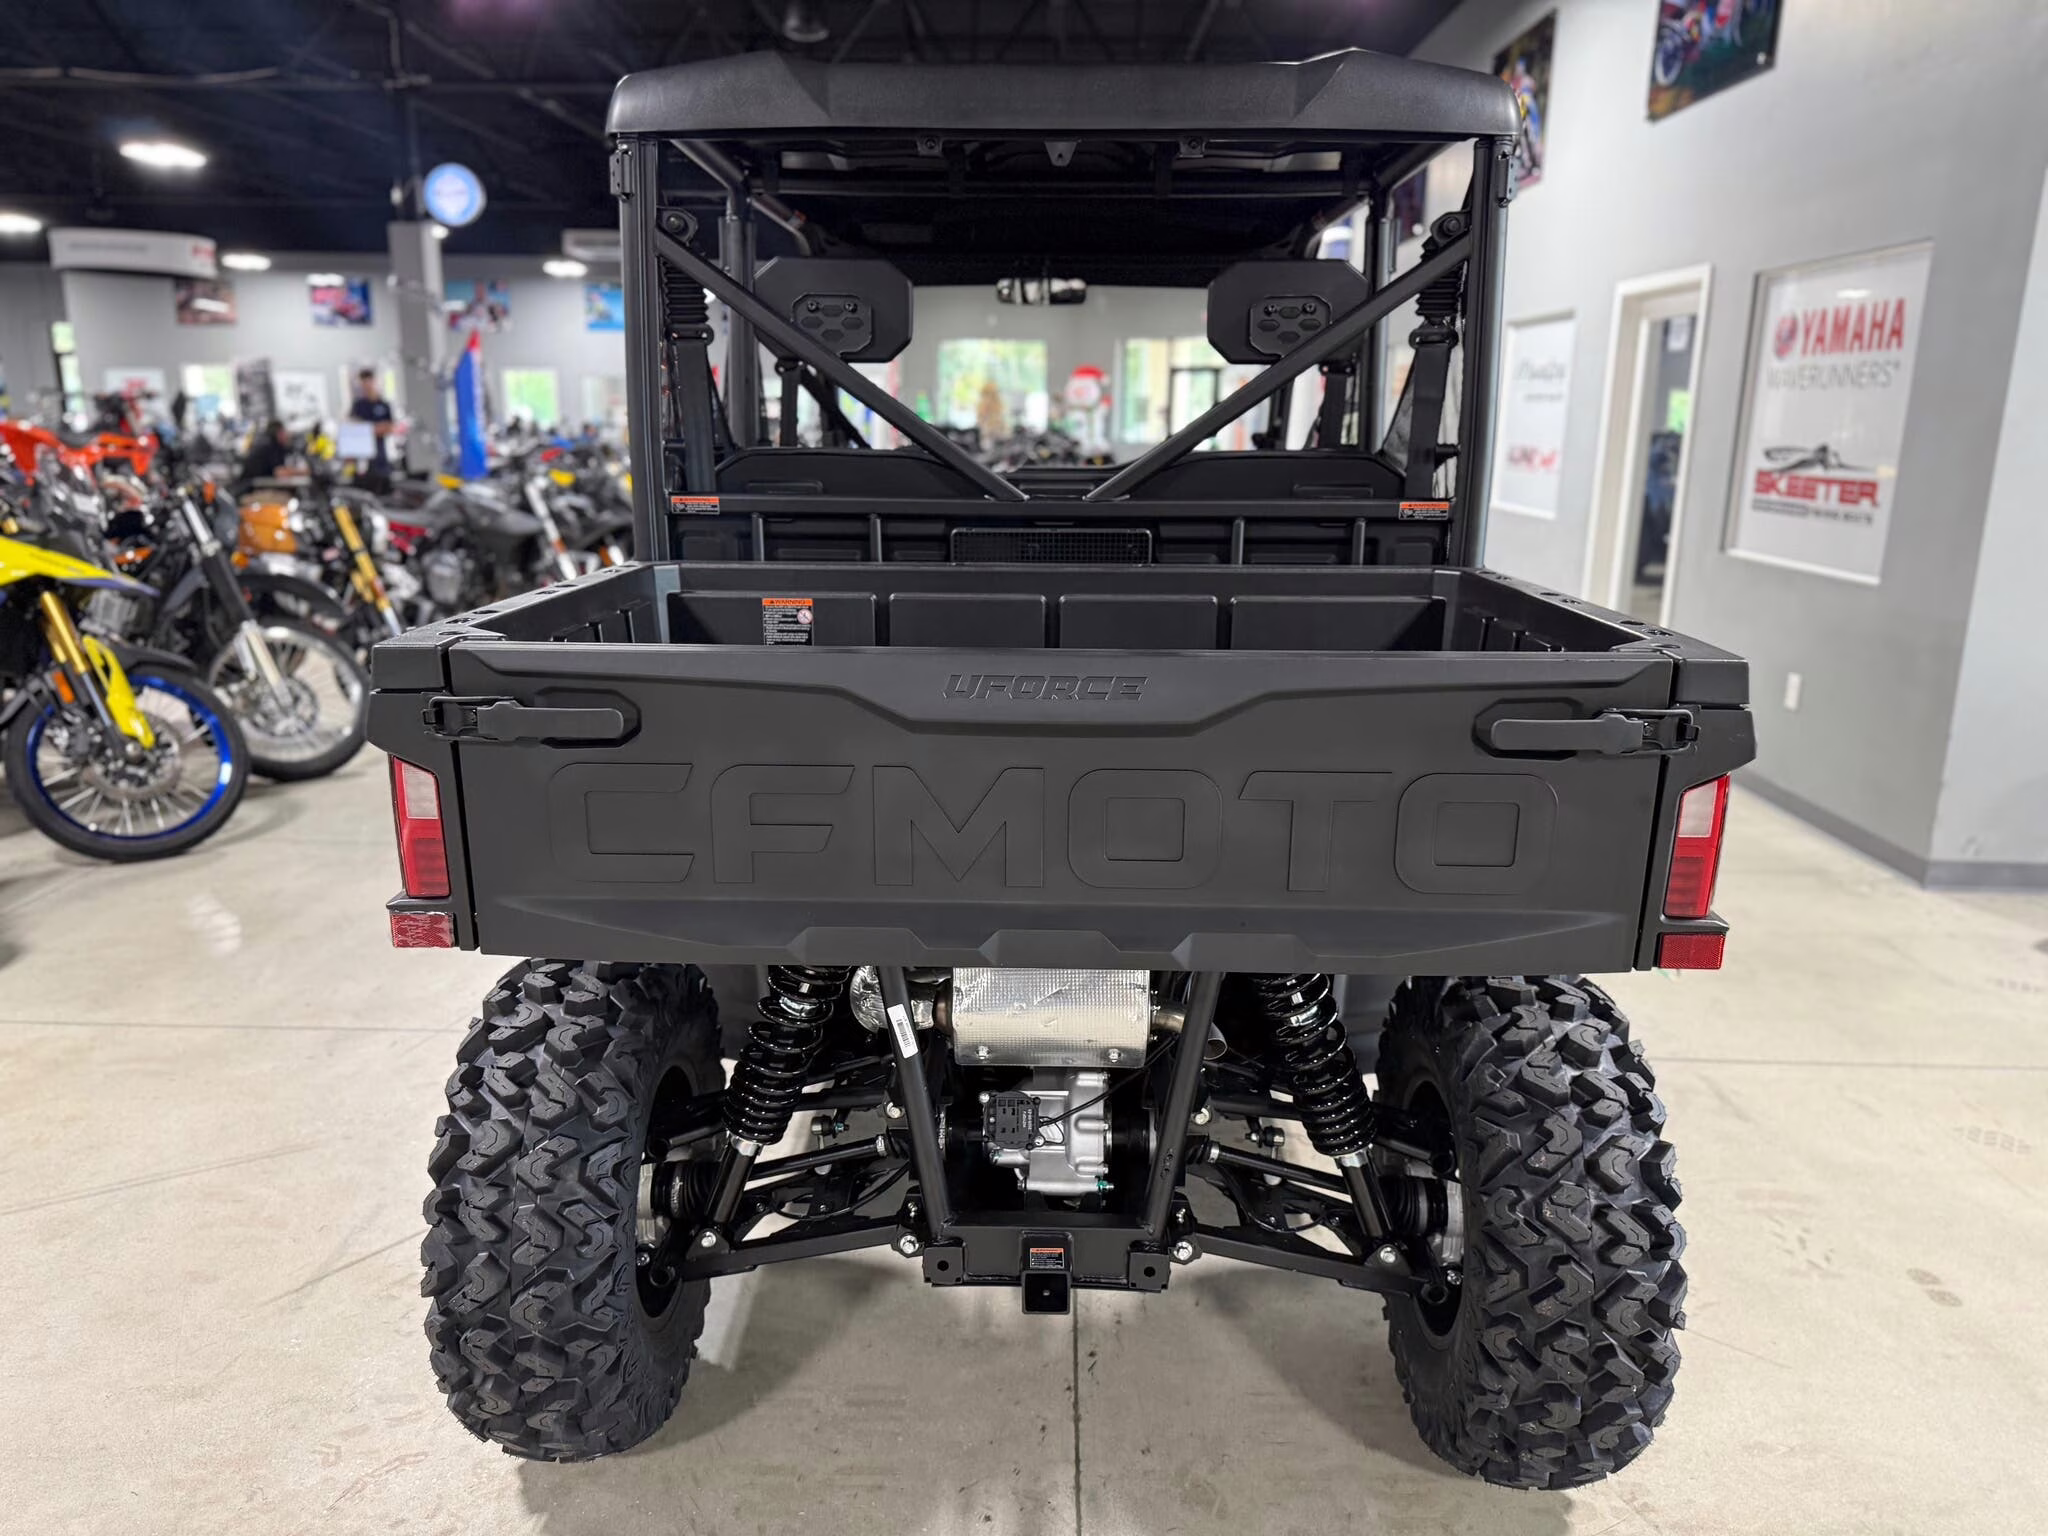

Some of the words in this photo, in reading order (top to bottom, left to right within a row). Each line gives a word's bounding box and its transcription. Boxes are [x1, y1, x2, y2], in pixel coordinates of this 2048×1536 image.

[1802, 298, 1905, 356] YAMAHA
[1754, 470, 1879, 507] SKEETER
[943, 674, 1149, 700] UFORCE
[549, 763, 1559, 894] CFMOTO
